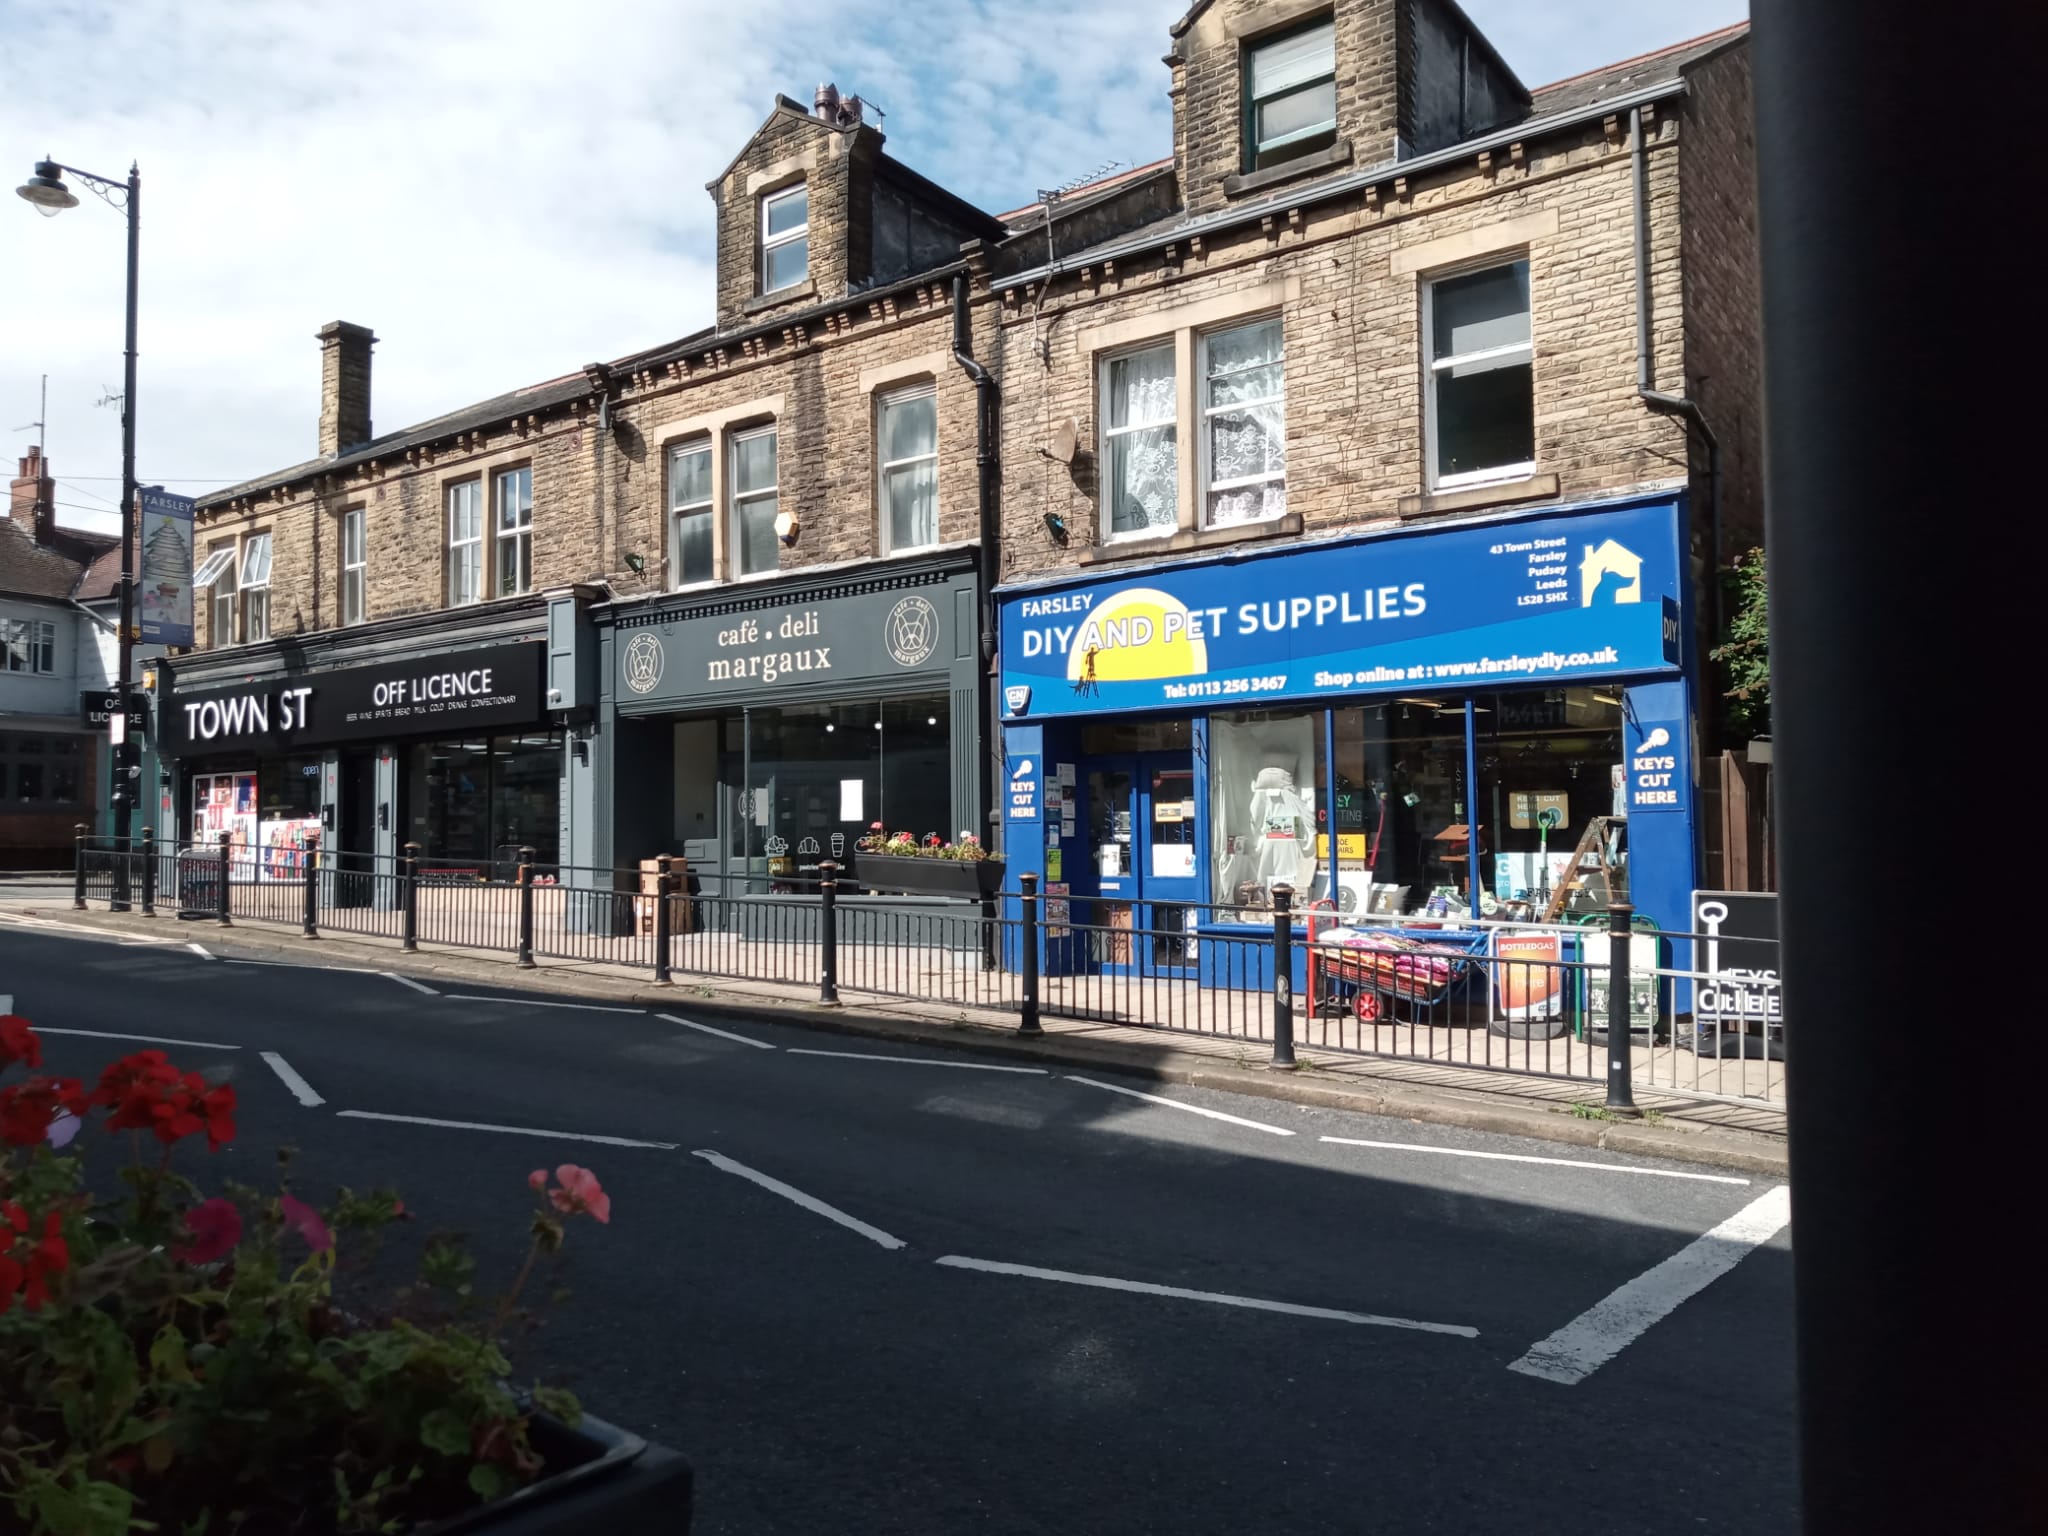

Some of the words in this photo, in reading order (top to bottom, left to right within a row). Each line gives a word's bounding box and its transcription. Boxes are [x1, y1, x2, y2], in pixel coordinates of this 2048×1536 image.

[145, 495, 191, 512] FARSLEY
[1490, 545, 1504, 554] 43
[1505, 541, 1532, 553] Town
[1534, 537, 1567, 549] Street
[1528, 551, 1567, 565] Farsley
[1528, 565, 1567, 578] Pudsey
[1536, 578, 1567, 591] Leeds
[1022, 594, 1093, 618] FARSLEY
[1517, 594, 1544, 606] LS28
[1023, 625, 1075, 657] DIY
[1082, 615, 1154, 652] AND
[1163, 607, 1228, 643] PET
[1238, 582, 1426, 635] SUPPLIES
[717, 619, 759, 647] café
[779, 611, 819, 640] deli
[1664, 615, 1678, 644] DIY
[708, 648, 832, 684] margaux
[1314, 670, 1354, 688] Shop
[1355, 666, 1405, 684] online
[1407, 665, 1424, 680] at
[1434, 645, 1619, 678] www.farsleydiy.co.uk
[374, 681, 407, 706] OFF
[412, 669, 493, 702] LICENCE
[1163, 683, 1187, 699] Tel:
[1188, 679, 1221, 697] 0113
[1223, 676, 1250, 695] 256
[1251, 674, 1287, 692] 3467
[184, 693, 269, 740] TOWN
[279, 688, 312, 731] ST
[303, 765, 319, 777] open
[1634, 756, 1675, 771] KEYS
[1010, 782, 1036, 793] KEYS
[1639, 773, 1672, 787] CUT
[1013, 794, 1033, 805] CUT
[1635, 790, 1678, 804] HERE
[1010, 807, 1036, 818] HERE
